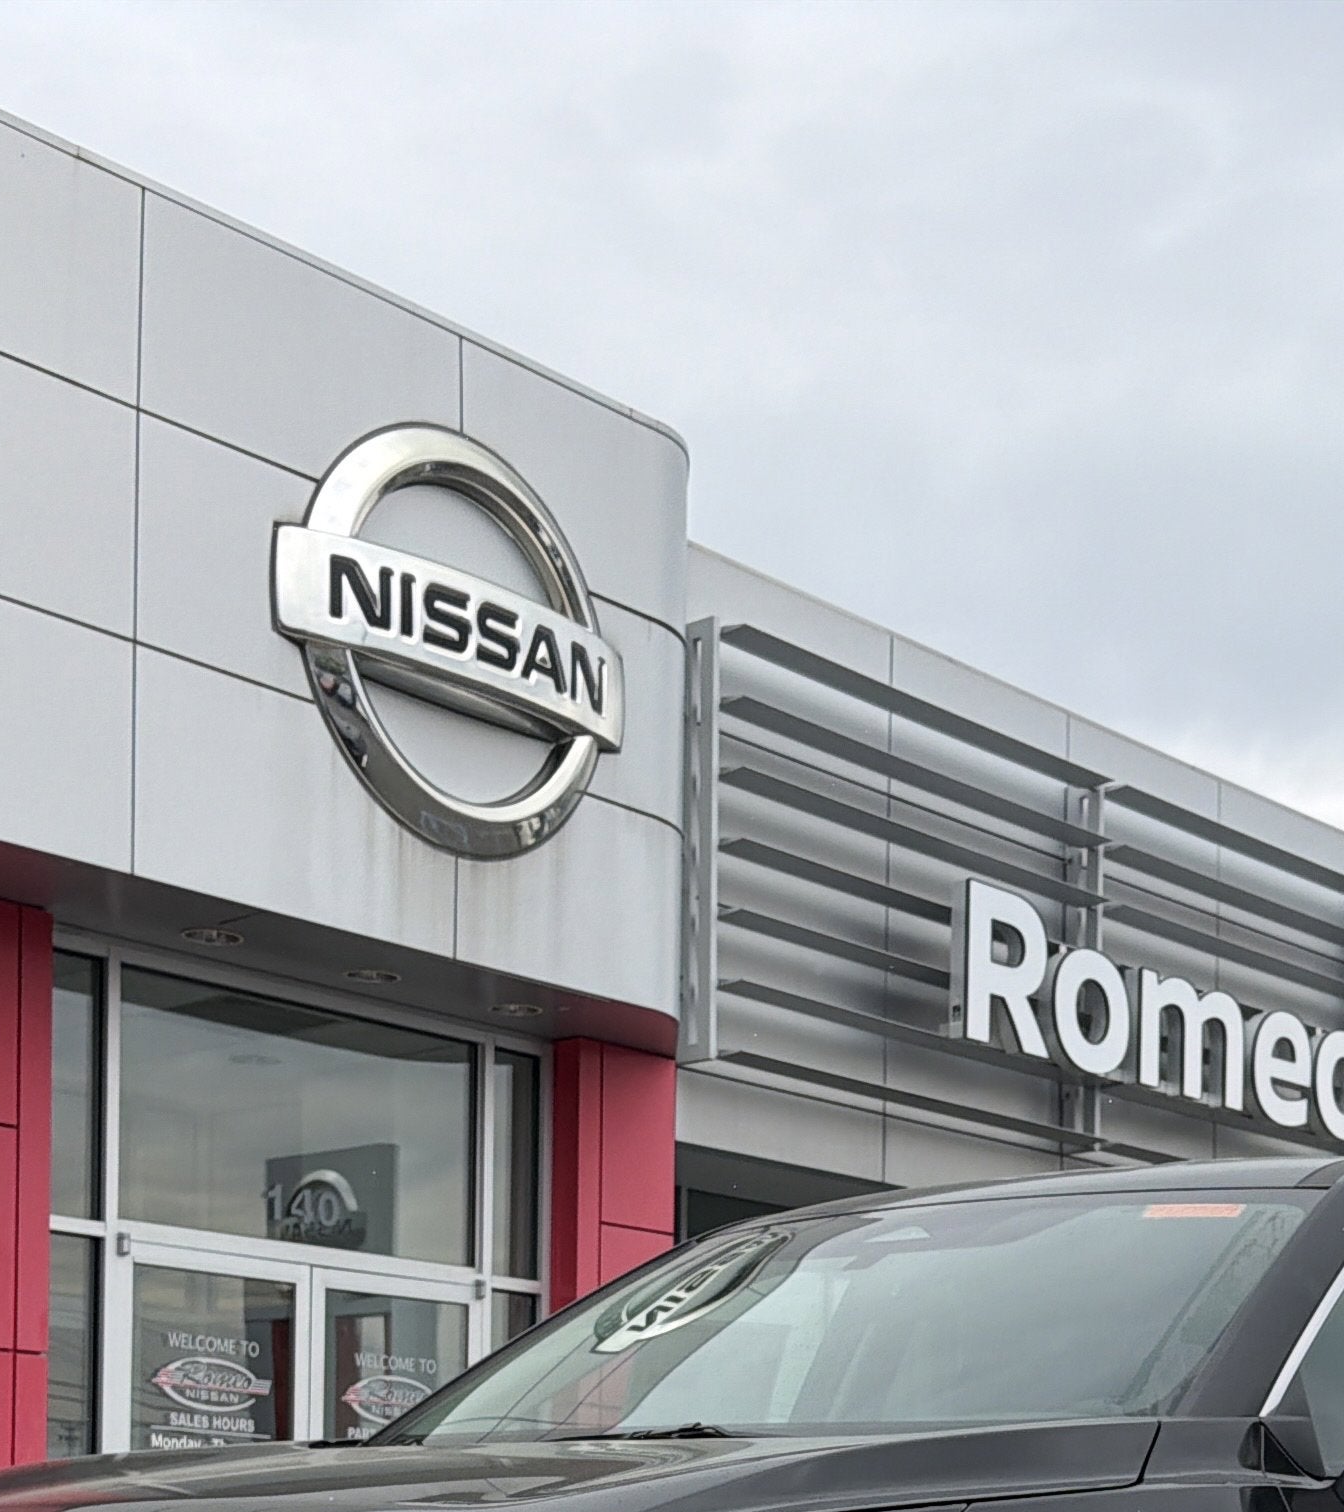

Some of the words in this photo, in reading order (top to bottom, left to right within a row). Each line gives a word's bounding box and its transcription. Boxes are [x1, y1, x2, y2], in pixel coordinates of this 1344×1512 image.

[329, 553, 606, 717] NISSAN
[268, 1184, 339, 1227] 140
[168, 1332, 236, 1355] WELCOME
[240, 1340, 260, 1358] TO
[354, 1353, 415, 1372] WELCOME
[419, 1359, 437, 1375] TO
[185, 1388, 240, 1404] NISSAN
[169, 1411, 210, 1429] SALES
[212, 1416, 256, 1433] HOURS
